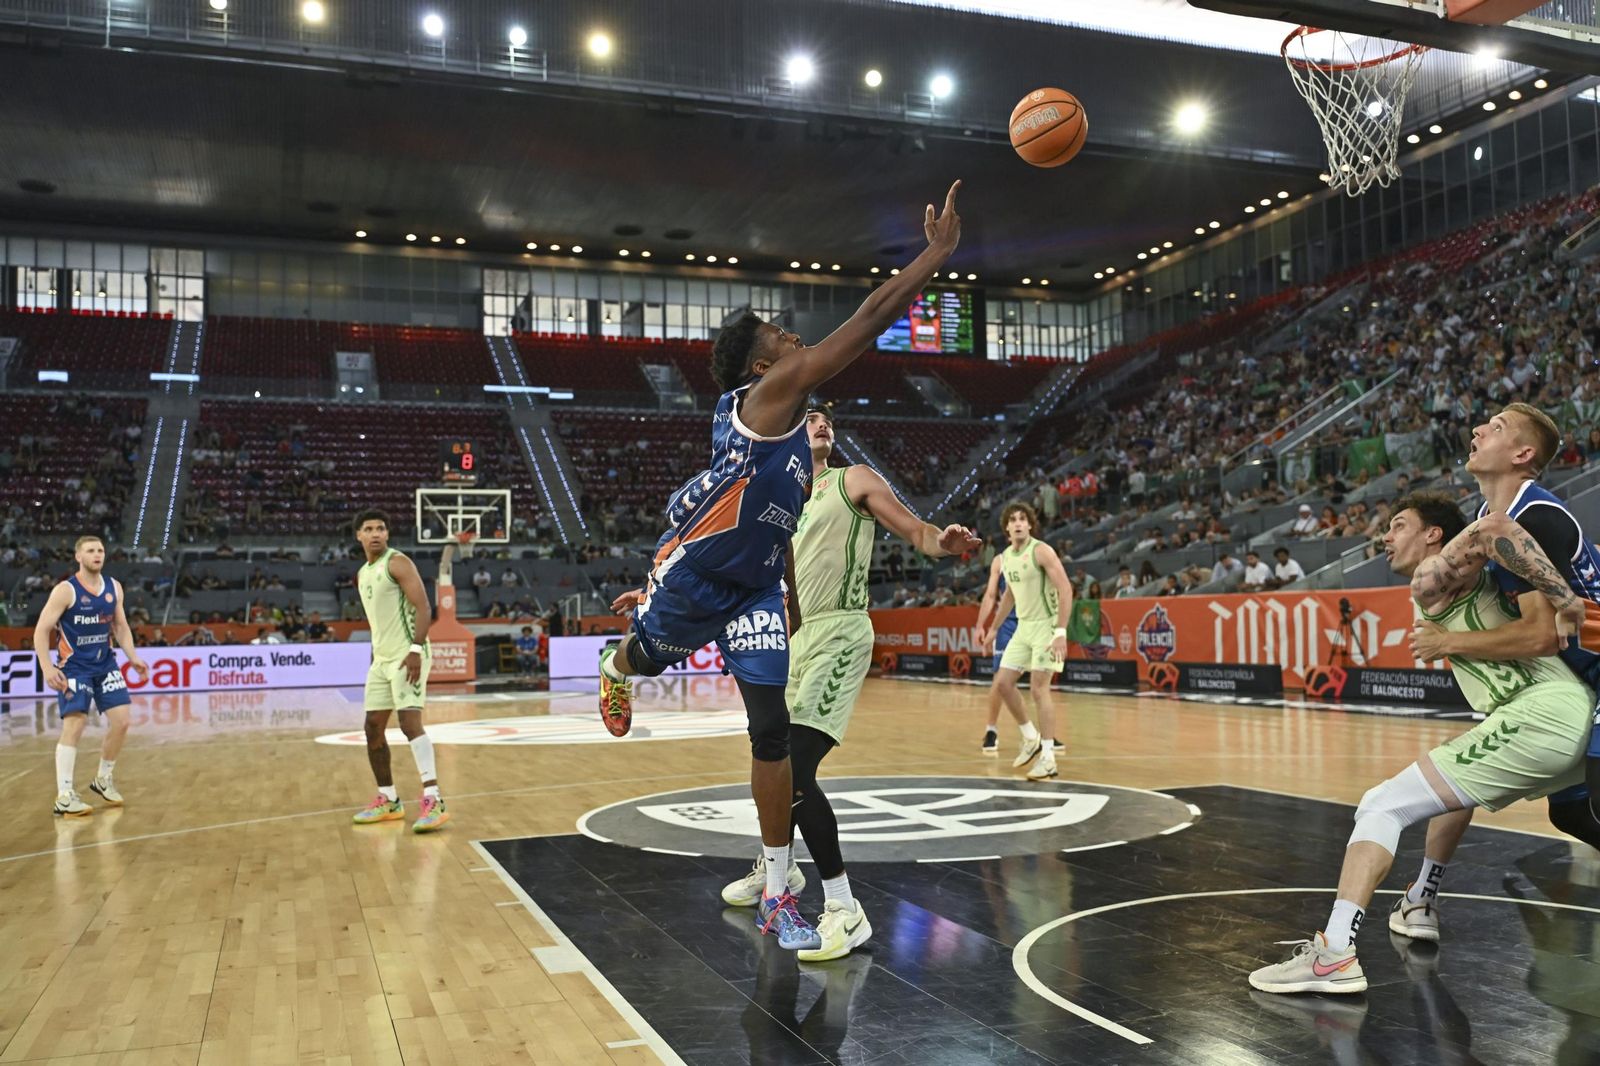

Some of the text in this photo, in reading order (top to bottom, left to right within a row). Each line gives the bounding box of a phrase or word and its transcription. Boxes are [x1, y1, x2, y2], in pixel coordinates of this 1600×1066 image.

[462, 453, 473, 470] 8
[725, 610, 785, 639] PAPA
[728, 634, 786, 651] JOHNS
[208, 651, 316, 671] Compra. Vende.
[208, 671, 268, 686] Disfruta.
[1360, 671, 1452, 688] FEDERACIÓN ESPAÑOLA
[1360, 684, 1425, 699] DE BALONCESTO
